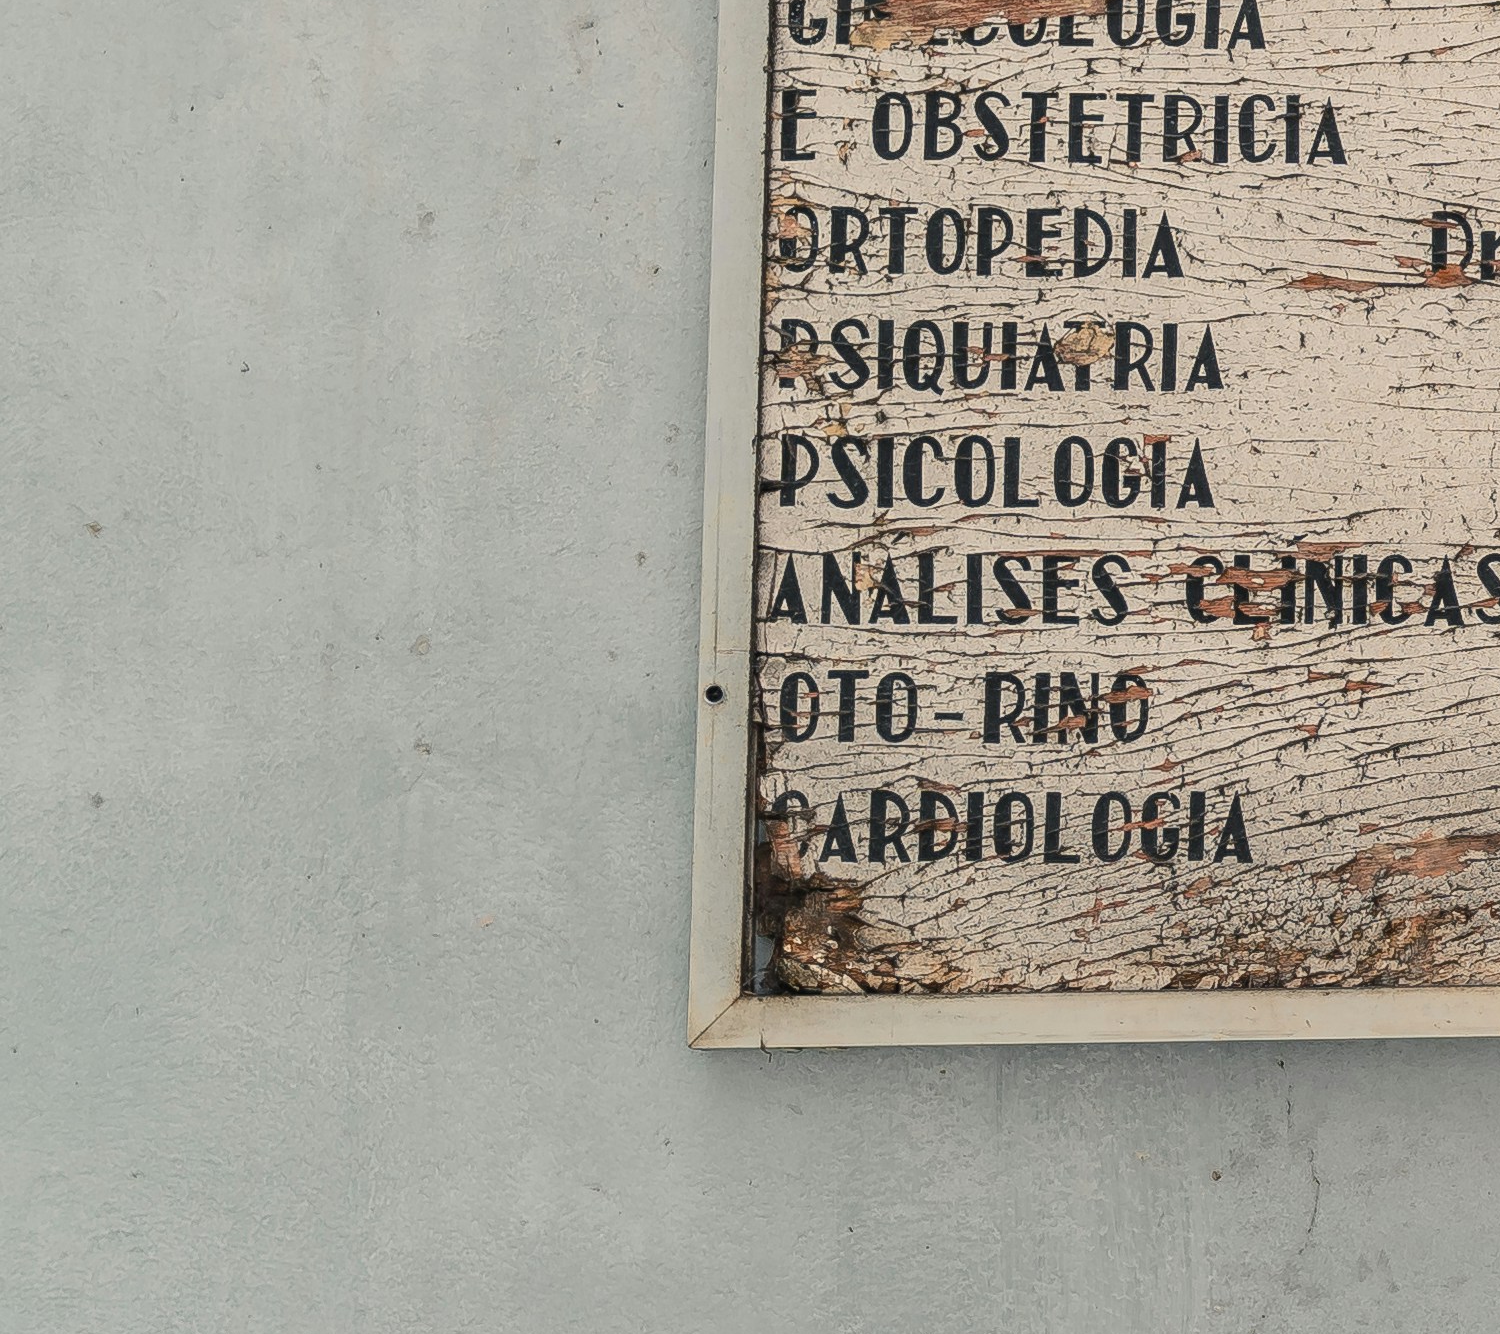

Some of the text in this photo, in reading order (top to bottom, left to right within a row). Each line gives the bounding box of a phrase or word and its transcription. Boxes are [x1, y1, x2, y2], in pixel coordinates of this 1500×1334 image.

[780, 89, 1348, 166] E OBSTETRICIA
[779, 206, 1185, 279] ORTOPEDIA
[778, 318, 1224, 396] PSIQUIATRIA
[779, 434, 1215, 510] PSICOLOGIA
